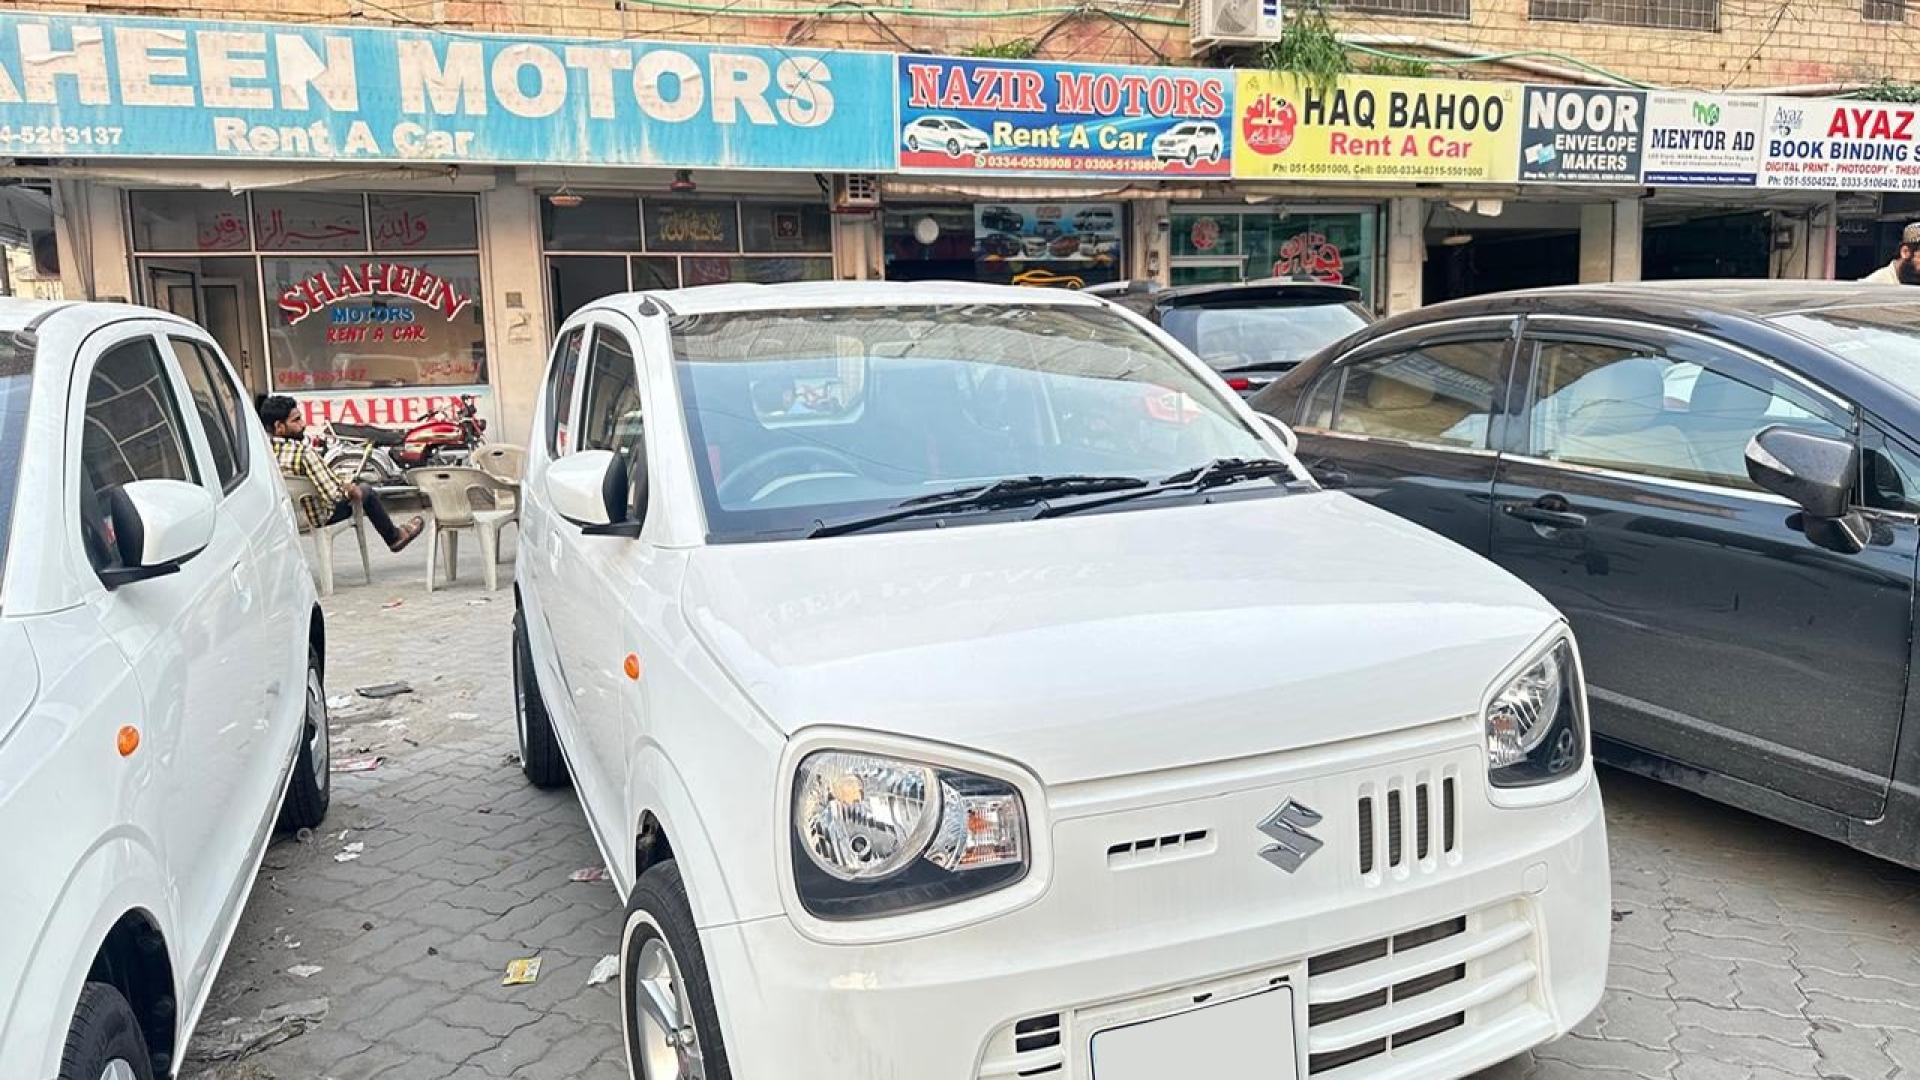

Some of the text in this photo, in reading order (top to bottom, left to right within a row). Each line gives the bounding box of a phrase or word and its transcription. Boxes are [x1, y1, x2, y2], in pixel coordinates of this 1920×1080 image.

[0, 23, 836, 127] HEEN MOTORS
[909, 64, 1224, 116] NAZIR MOTORS
[1304, 87, 1376, 130] HAQ
[1388, 91, 1504, 132] BAHOO
[1528, 91, 1639, 132] NOOR
[993, 121, 1149, 151] Rent A Car
[1827, 107, 1915, 139] AYAZ
[213, 116, 475, 157] Rent A Car
[1330, 132, 1472, 158] Rent A Car
[1555, 135, 1637, 153] ENVELOPE
[1651, 129, 1755, 151] MENTOR AD
[1562, 153, 1627, 171] MAKERS
[1769, 140, 1824, 159] BOOK
[1830, 142, 1908, 161] BINDING
[1765, 161, 1800, 172] DIGITAL
[1802, 162, 1829, 173] PRINT
[1836, 163, 1887, 174] PHOTOCOPY
[1768, 175, 1781, 186] Ph:
[278, 263, 472, 326] SHAHEEN
[331, 306, 415, 324] MOTORS
[326, 325, 429, 343] RENT A CAR
